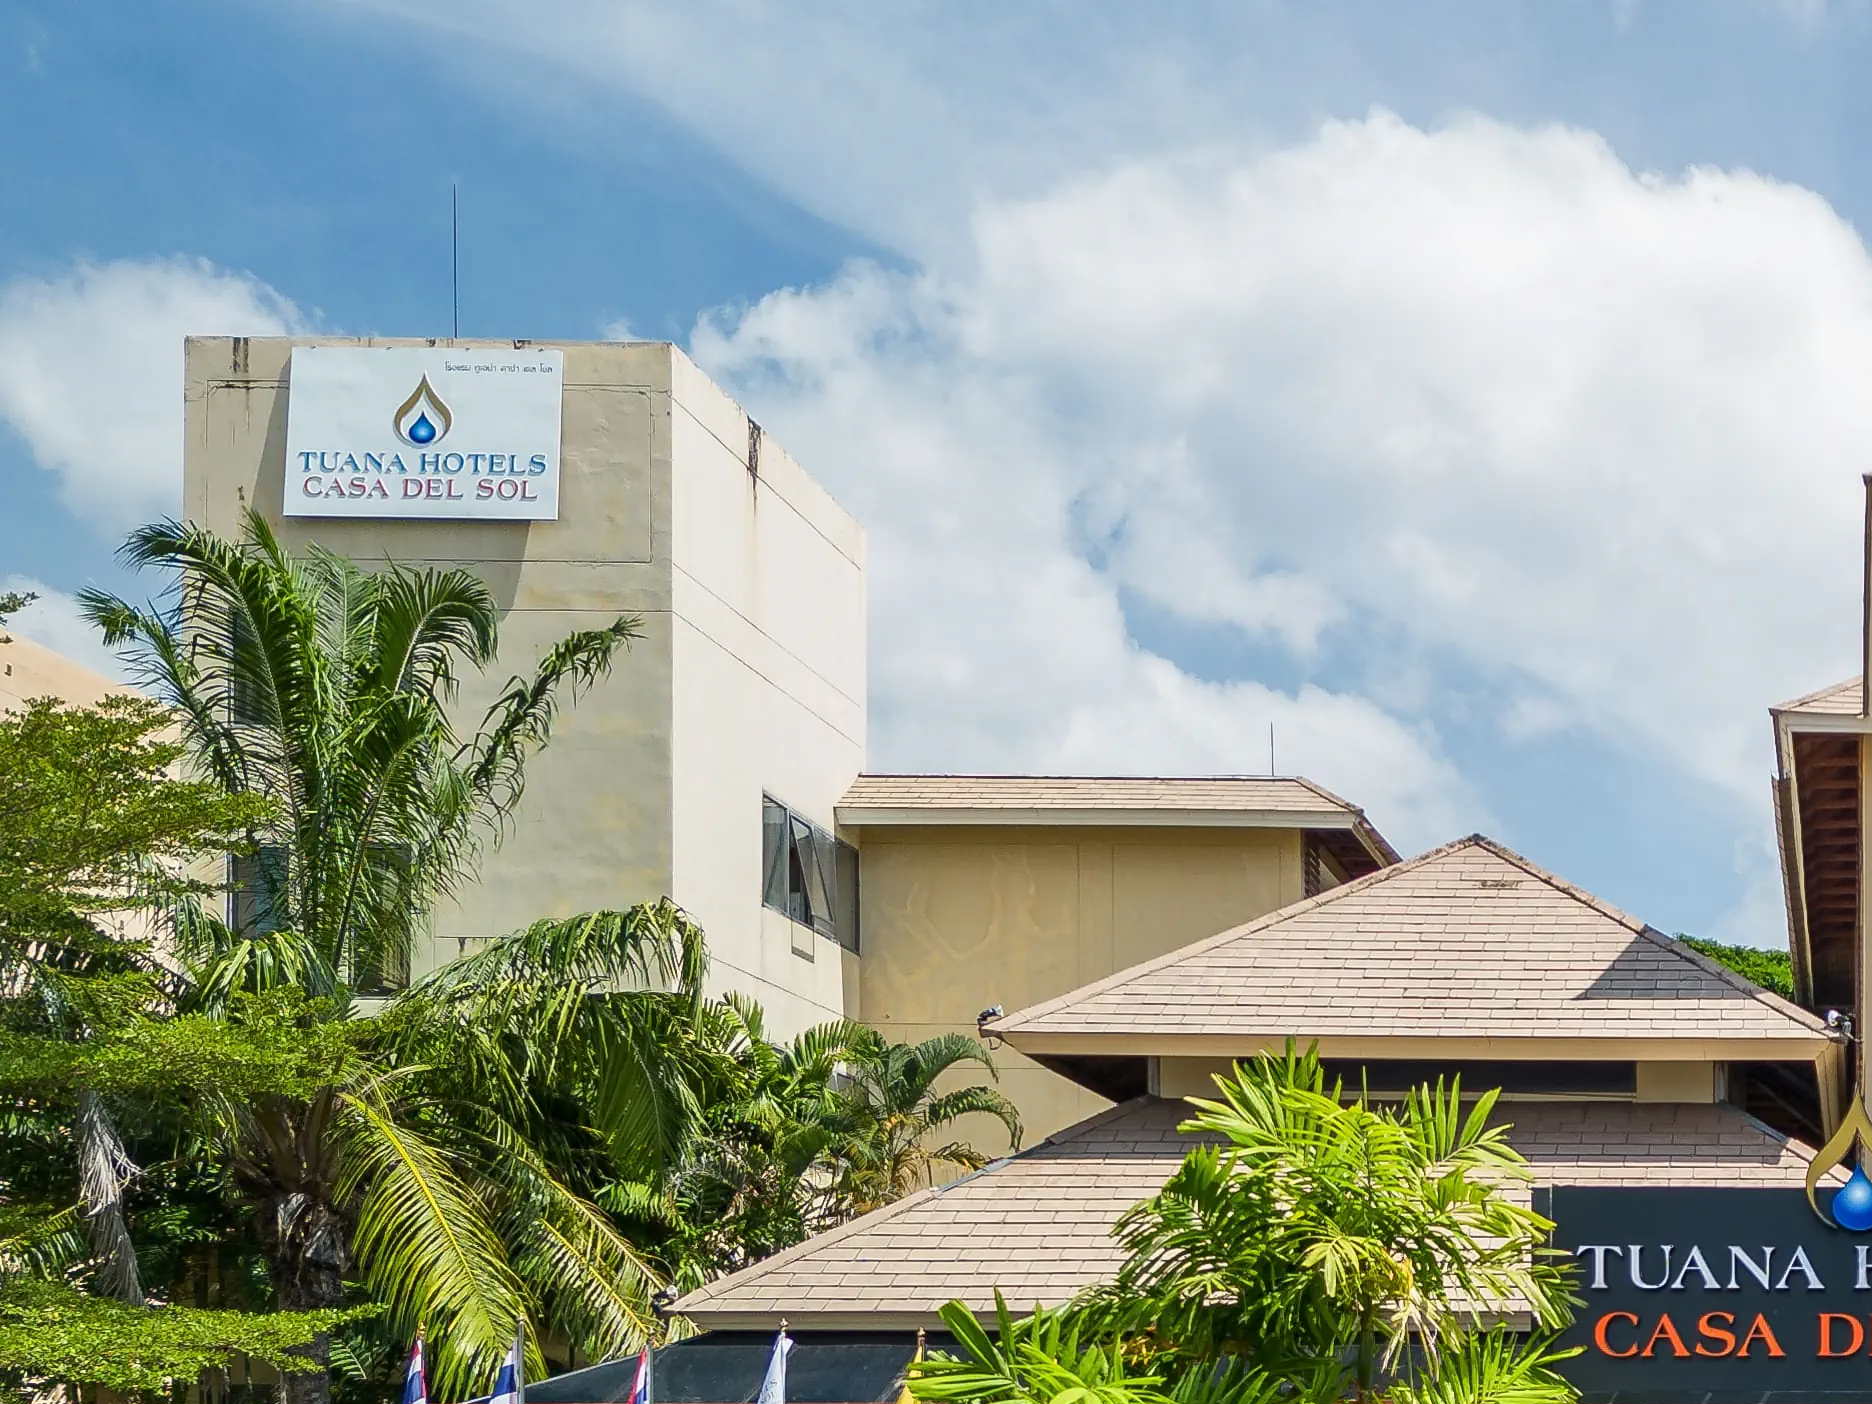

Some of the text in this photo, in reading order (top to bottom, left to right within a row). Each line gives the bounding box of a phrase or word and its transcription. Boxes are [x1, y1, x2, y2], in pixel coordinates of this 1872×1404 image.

[297, 451, 547, 476] TUANA HOTELS
[303, 476, 538, 502] CASA DEL SOL
[1577, 1244, 1825, 1290] TUANA
[1594, 1311, 1786, 1358] CASA
